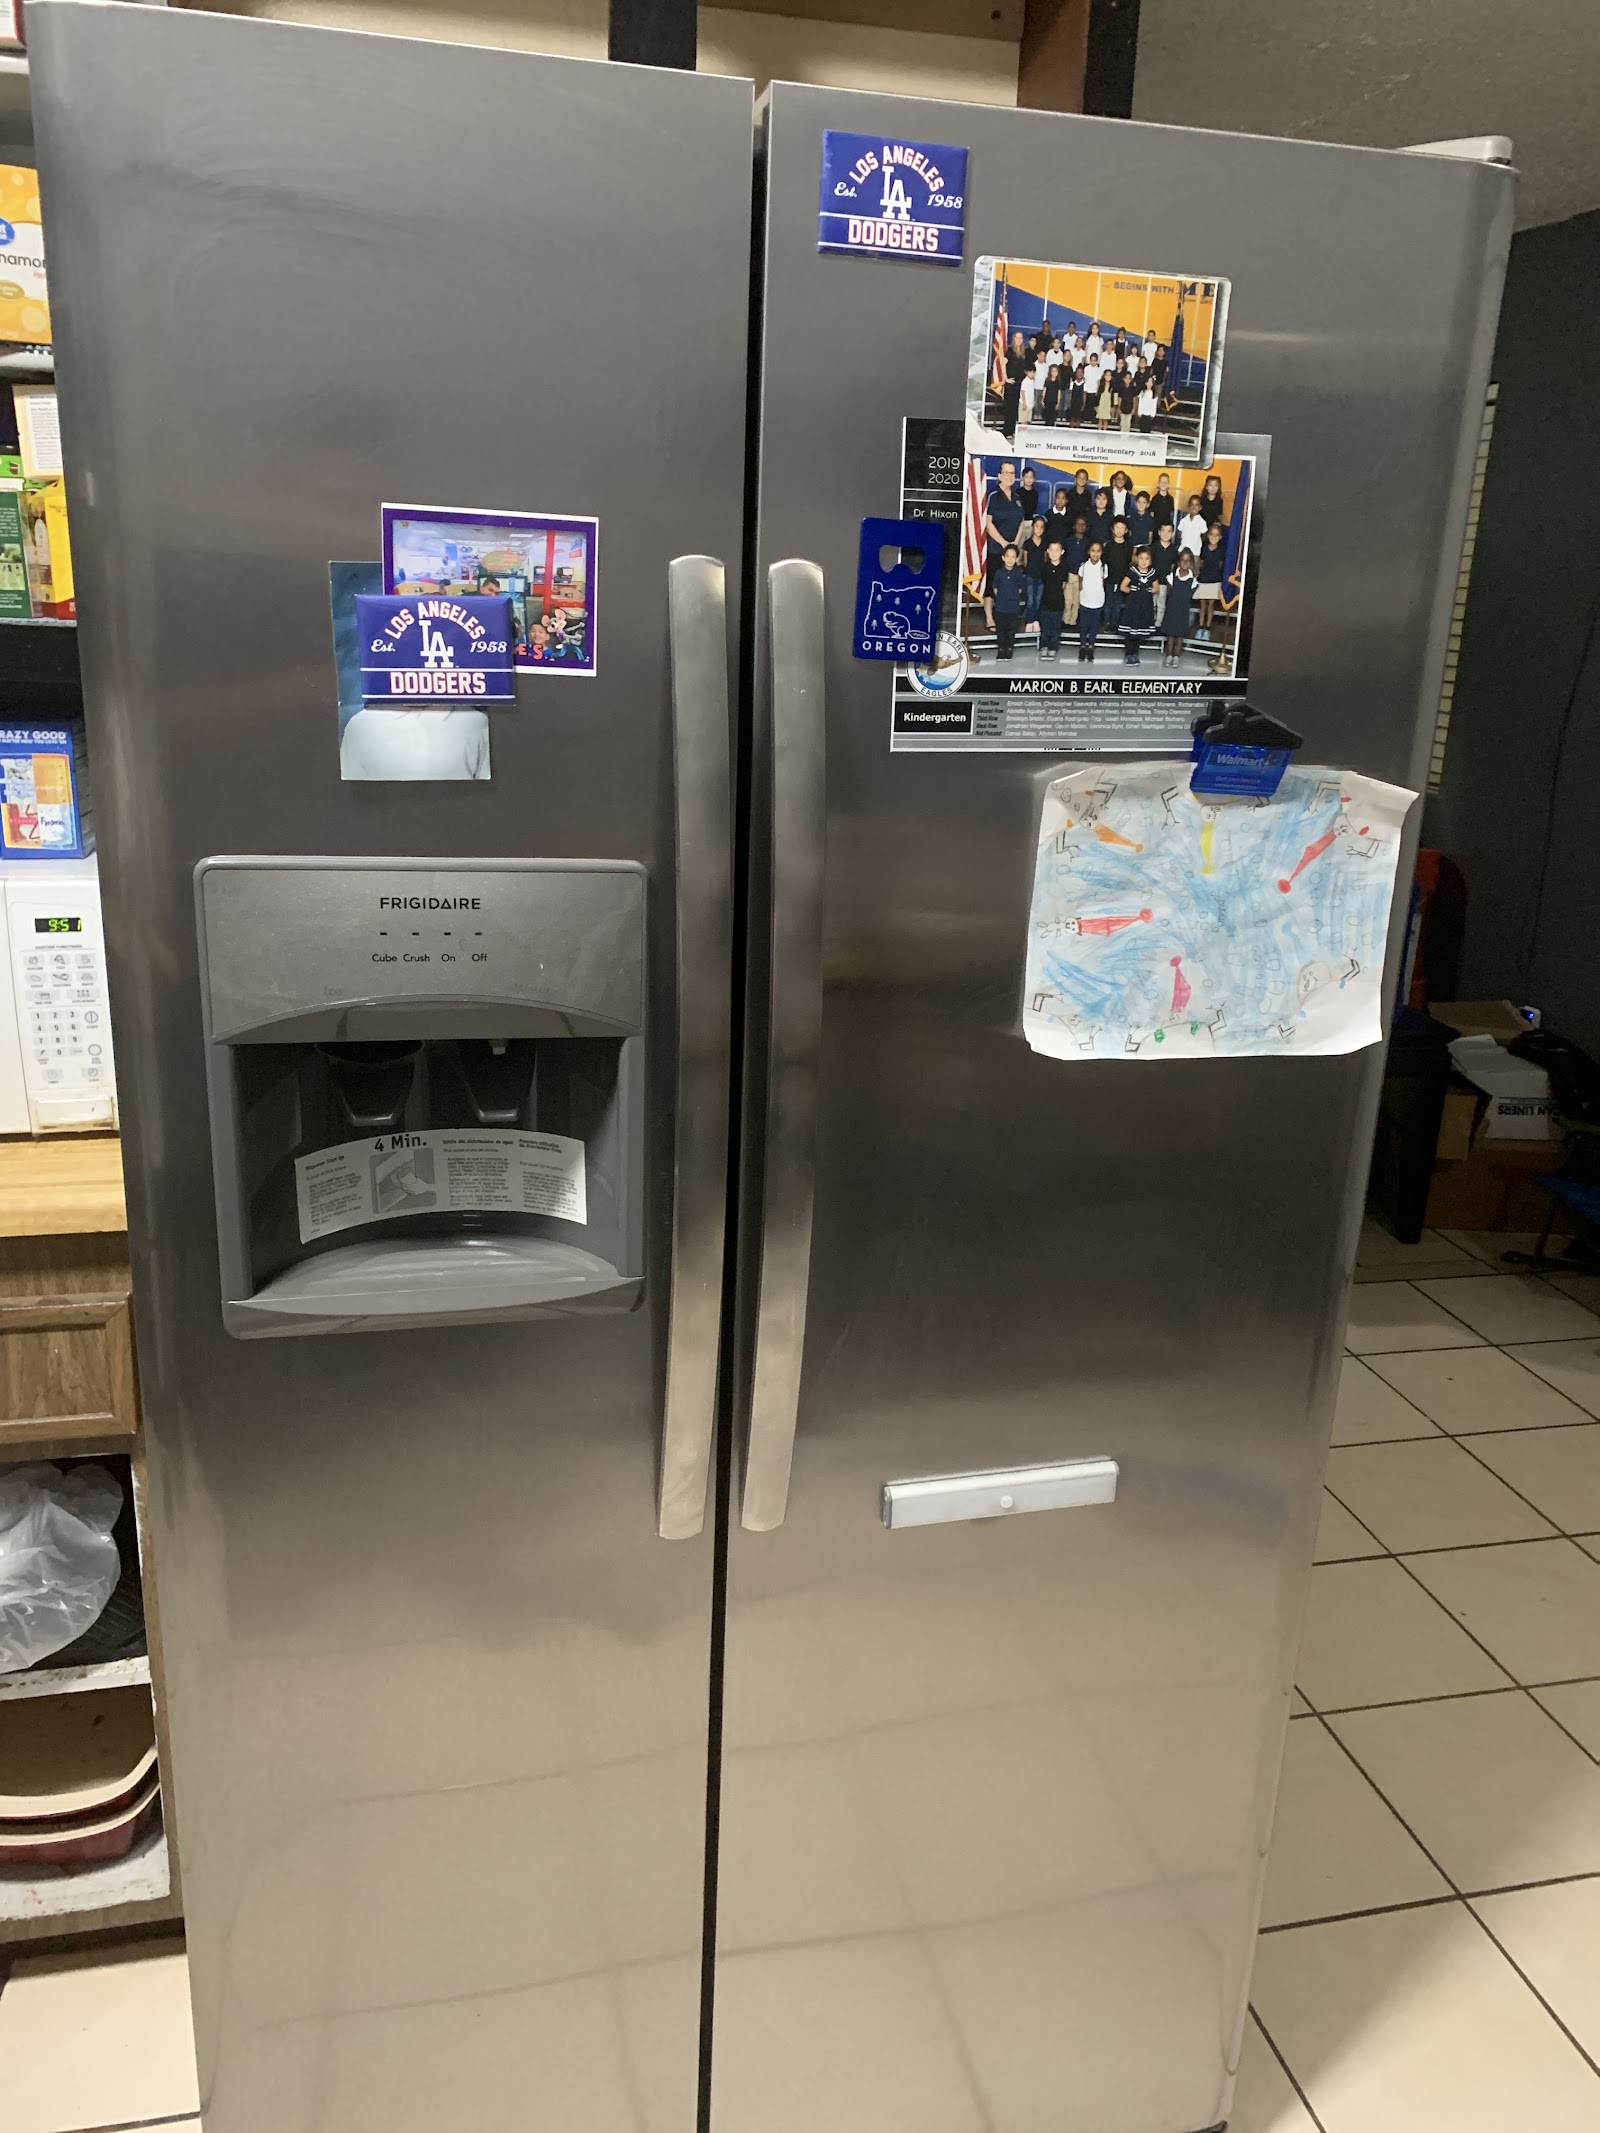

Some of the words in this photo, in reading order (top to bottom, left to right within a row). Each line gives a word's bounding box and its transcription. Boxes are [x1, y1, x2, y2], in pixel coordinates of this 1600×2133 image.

[849, 152, 878, 184] LOS
[883, 146, 944, 192] ANGELES
[834, 182, 857, 197] Est.
[880, 166, 912, 221] LA
[927, 194, 963, 208] 1958
[848, 219, 939, 252] DODGERS
[1114, 282, 1148, 291] BEGINS
[1152, 286, 1174, 294] WITH
[1097, 446, 1135, 456] Elementary
[928, 457, 960, 470] 2019
[928, 474, 960, 484] 2020
[930, 510, 958, 518] Hixon
[385, 608, 414, 640] LOS
[418, 601, 486, 640] ANGELES
[371, 639, 396, 652] Est.
[418, 620, 454, 668] LA
[470, 641, 507, 653] 1958
[862, 640, 931, 654] OREGON
[390, 672, 486, 694] DODGERS
[1010, 680, 1064, 693] MARION
[1070, 682, 1080, 693] B.
[1084, 682, 1115, 694] EARL
[1122, 682, 1202, 694] ELEMENTARY
[920, 687, 952, 696] EAGLES
[904, 712, 966, 724] Kindergarten
[33, 731, 66, 740] GOOD
[380, 898, 480, 910] FRIGIDAIRE
[372, 953, 398, 962] Cube
[403, 953, 430, 962] Crush
[441, 954, 456, 962] On
[472, 953, 488, 962] Off
[374, 1137, 384, 1152] 4
[391, 1134, 428, 1150] Min.
